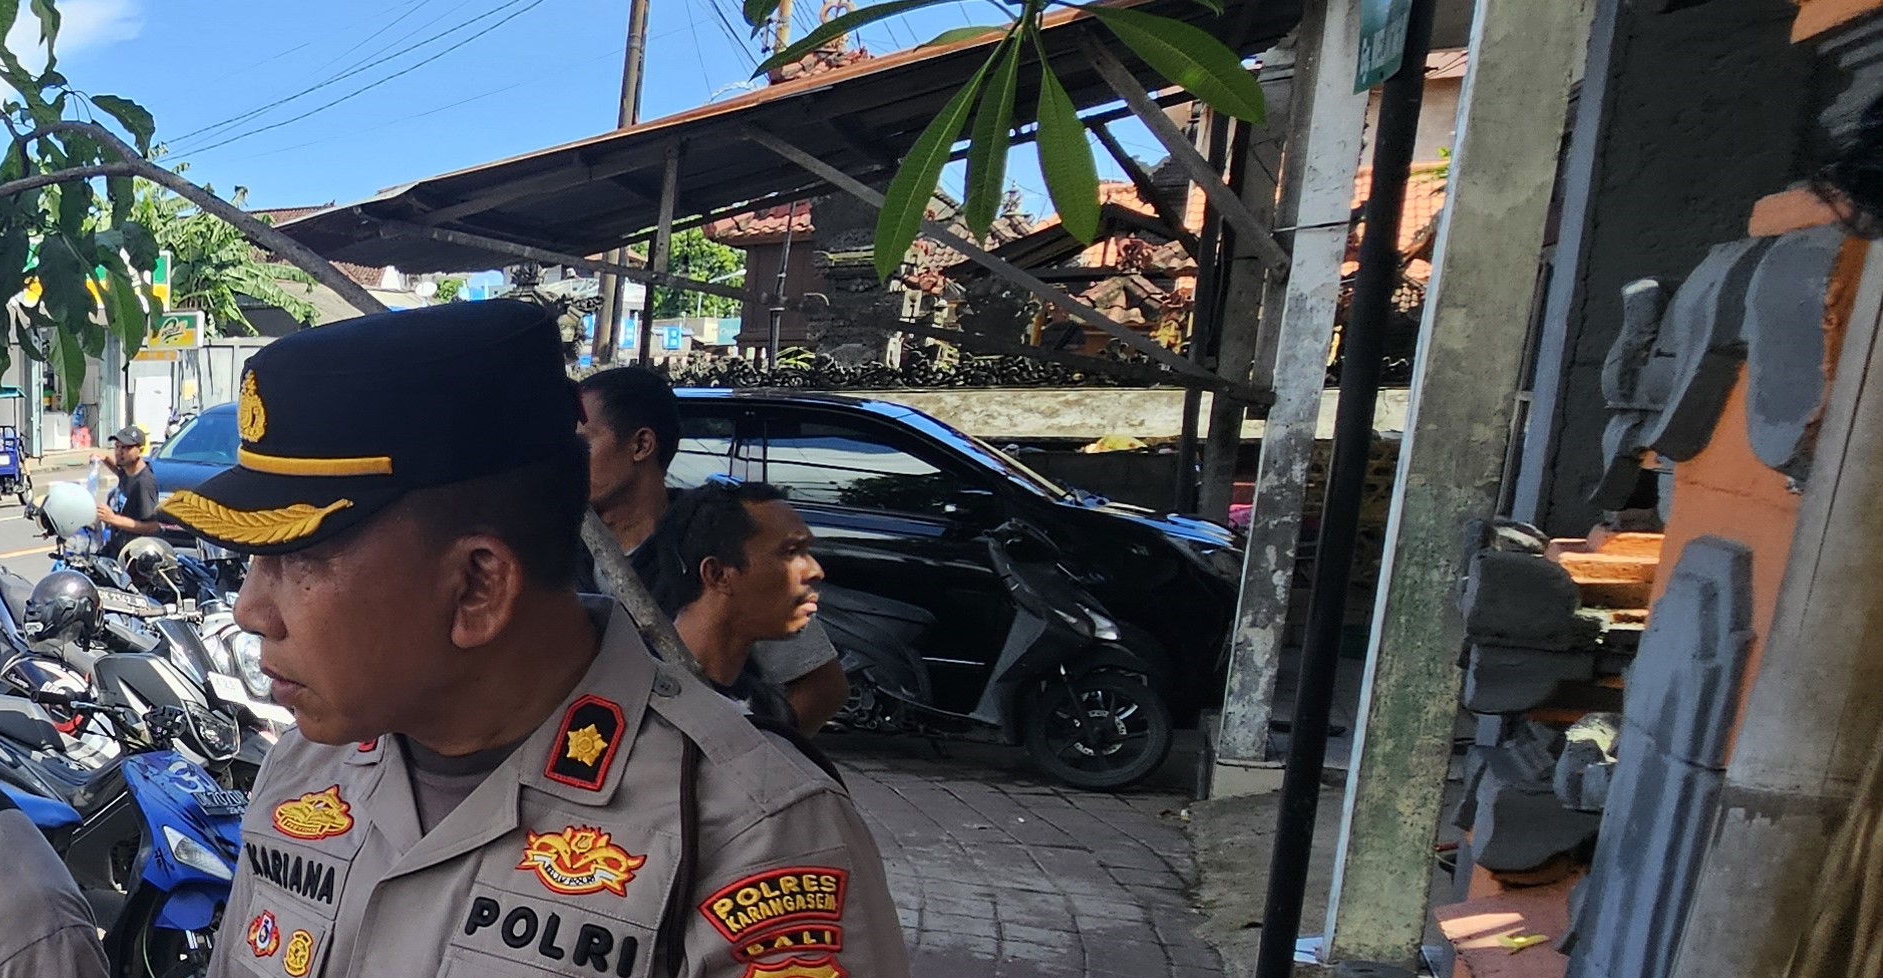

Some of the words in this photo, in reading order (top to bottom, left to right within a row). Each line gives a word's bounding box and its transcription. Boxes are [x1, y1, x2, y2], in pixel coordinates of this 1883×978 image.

[246, 842, 336, 905] KARIANA
[713, 874, 837, 920] POLRES
[725, 892, 836, 932] KARANGASEM
[746, 930, 831, 956] BALI
